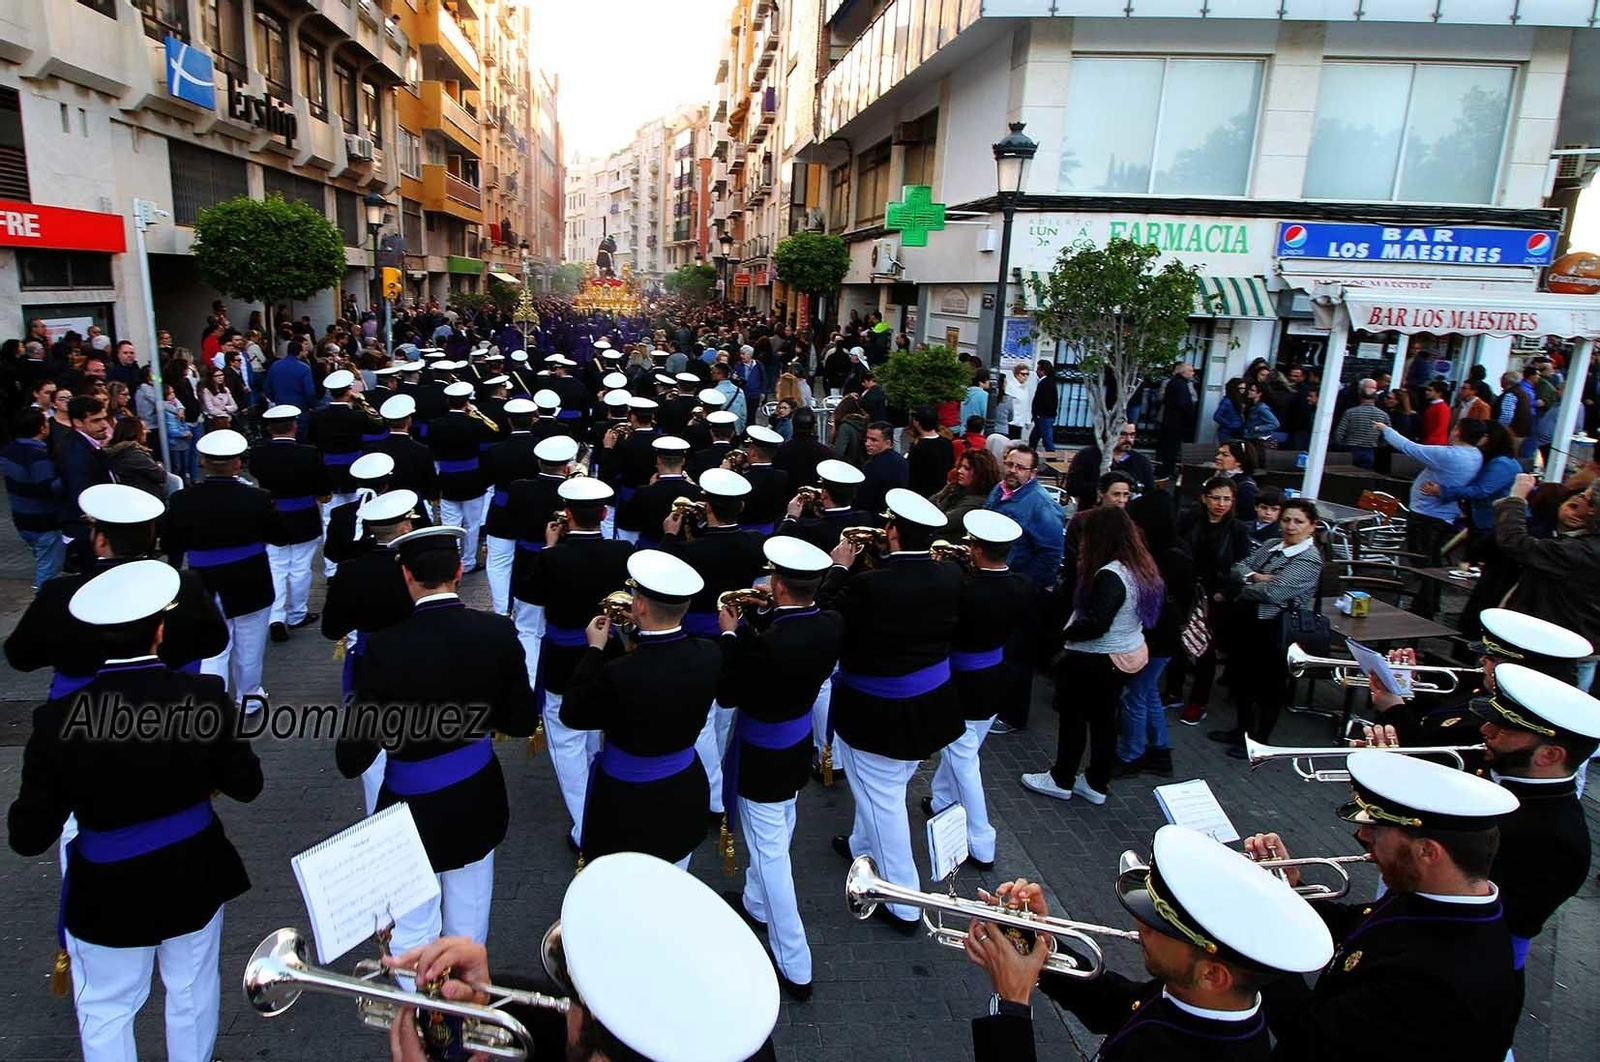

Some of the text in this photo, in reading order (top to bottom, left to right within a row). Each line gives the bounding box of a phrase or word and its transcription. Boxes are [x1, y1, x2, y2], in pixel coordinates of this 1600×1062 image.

[1109, 221, 1249, 254] FARMACIA
[1381, 227, 1454, 243] BAR
[1328, 242, 1502, 264] LOS MAESTRES
[1367, 306, 1538, 331] BAR LOS MAESTRES
